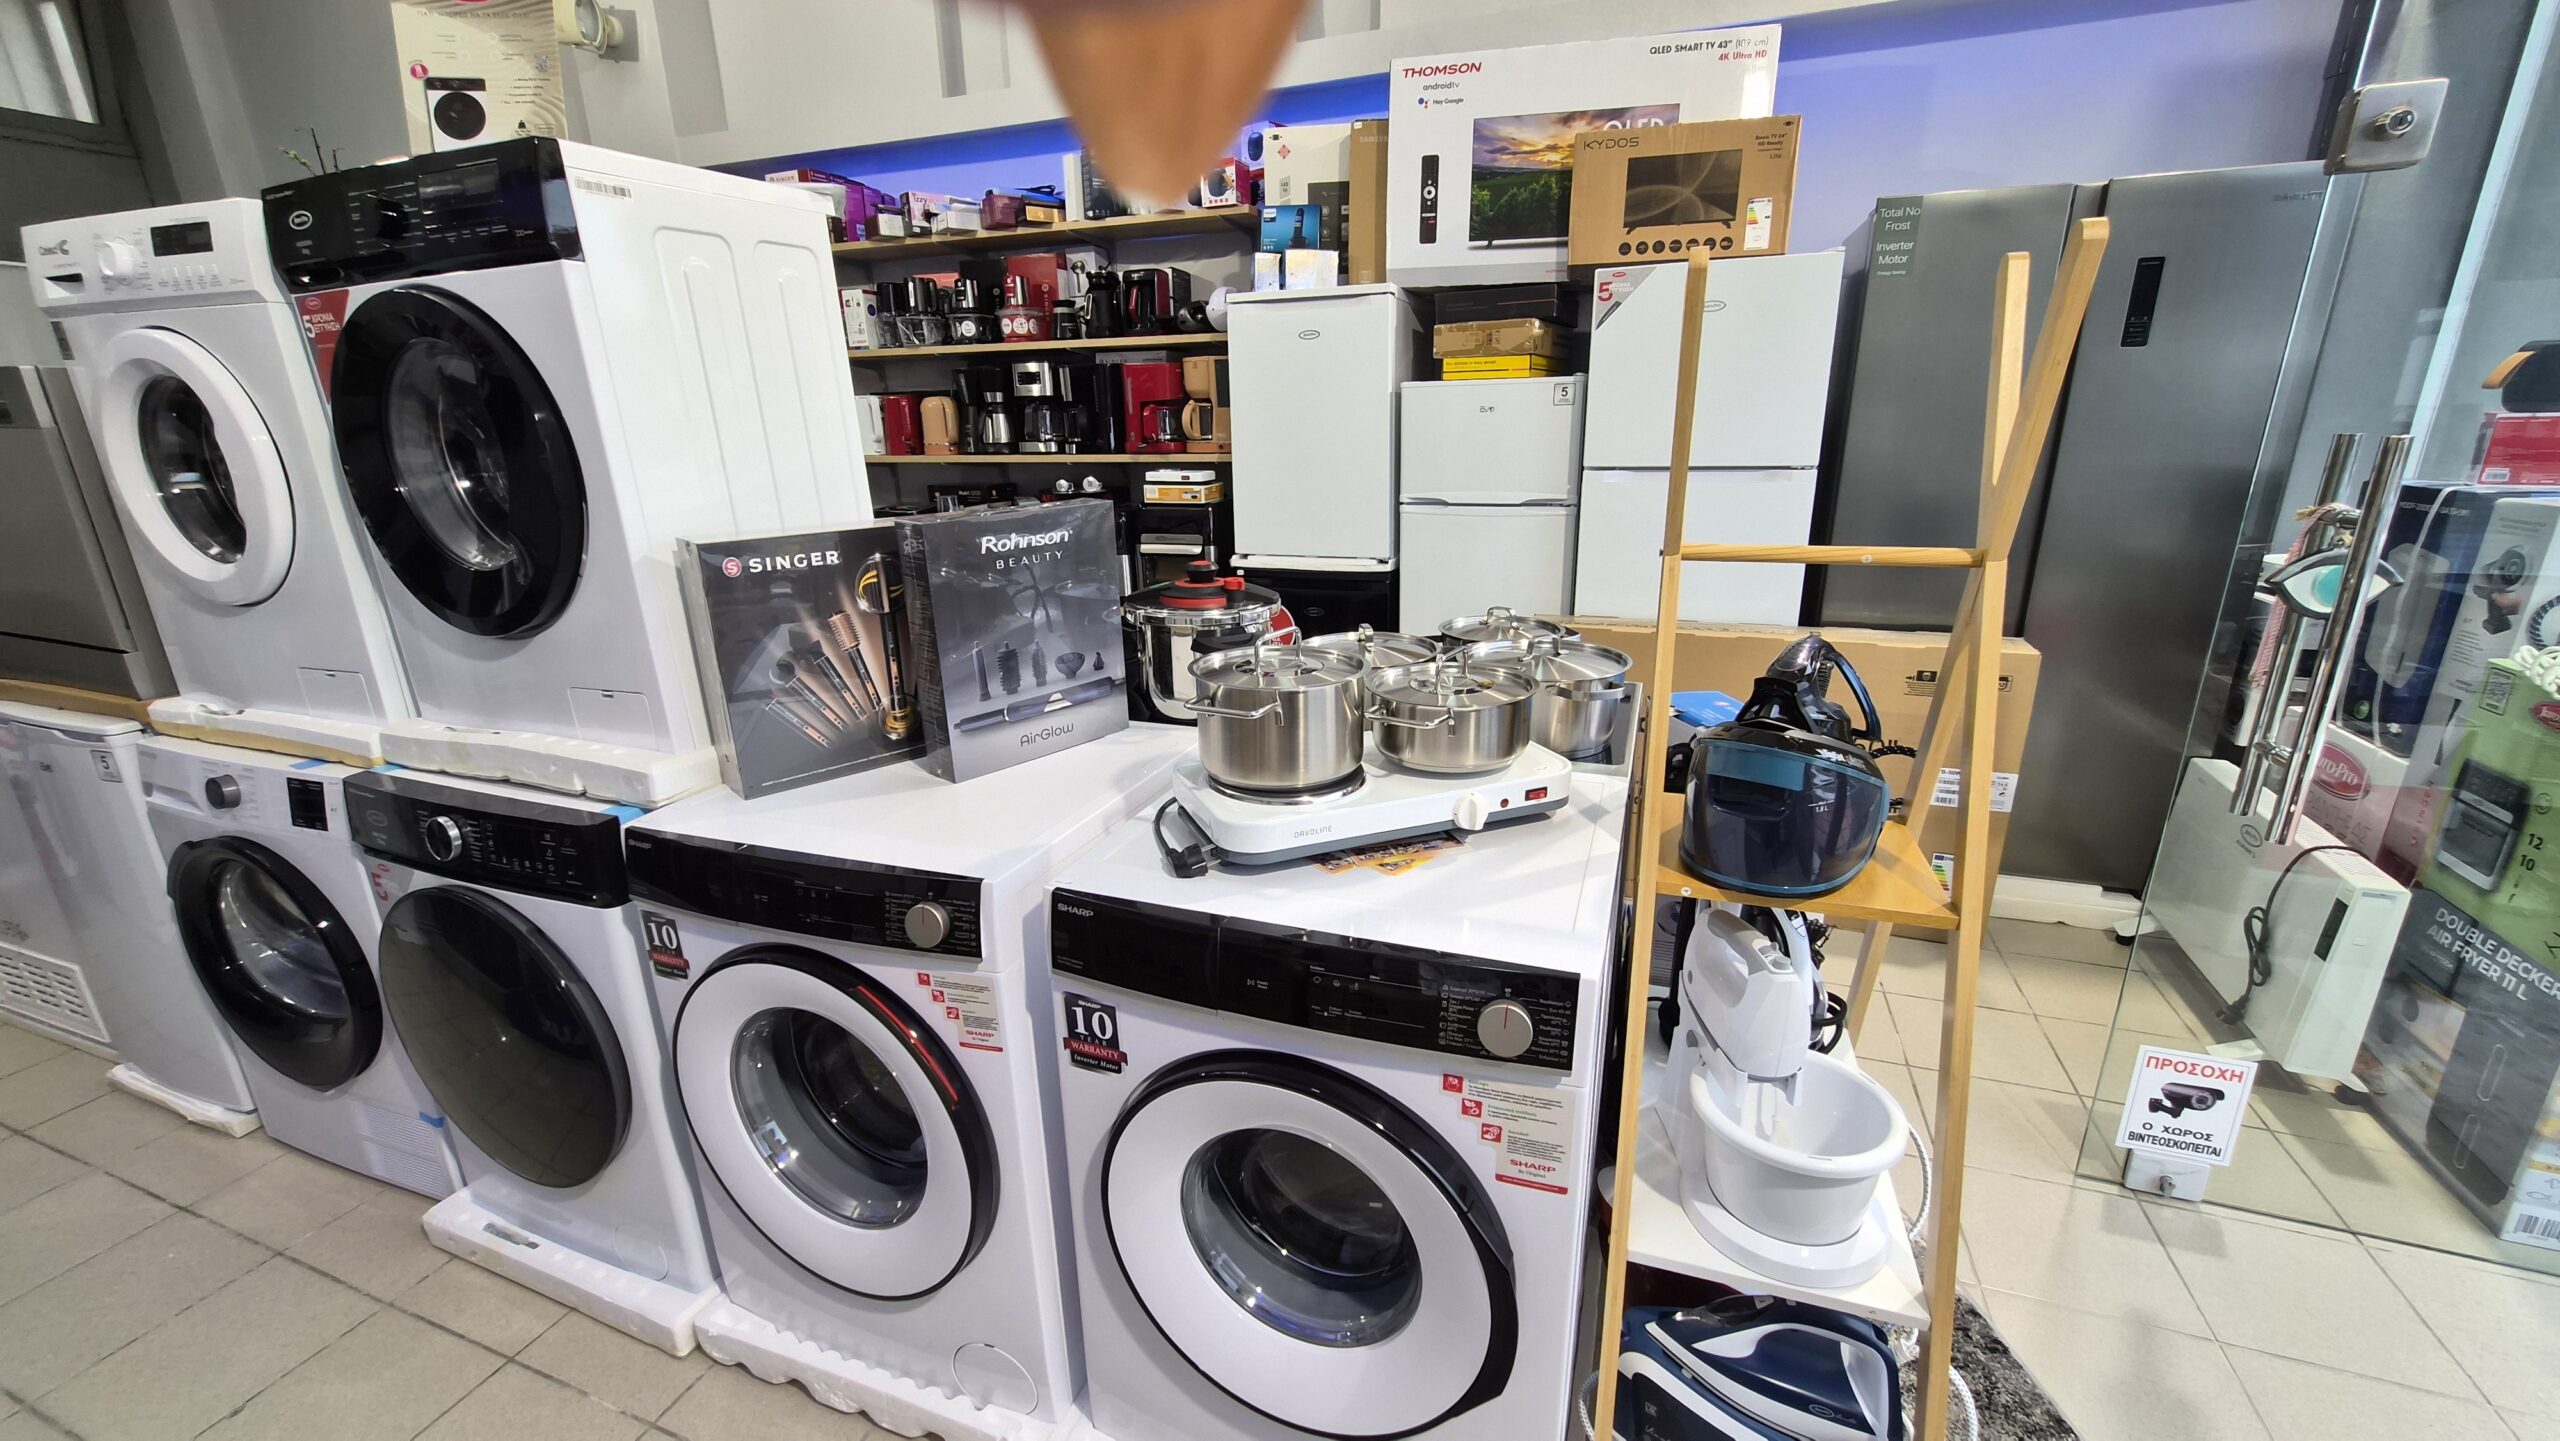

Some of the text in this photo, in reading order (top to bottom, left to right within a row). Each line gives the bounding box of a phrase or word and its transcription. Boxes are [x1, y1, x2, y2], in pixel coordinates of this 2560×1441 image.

[1650, 45, 1672, 55] QLED
[1674, 42, 1703, 53] SMART
[1706, 41, 1716, 50] TV
[1718, 49, 1767, 61] 4K Ultra HD
[1402, 62, 1482, 78] THOMSON
[1433, 96, 1464, 106] Hey Google
[1583, 136, 1640, 150] KYDOS
[1880, 206, 1920, 218] Total No
[1885, 221, 1911, 231] Frost
[1876, 241, 1915, 252] Inverter
[1878, 255, 1909, 265] Motor
[1597, 281, 1613, 302] 5
[302, 315, 316, 338] 5
[1561, 386, 1569, 397] 5
[981, 531, 1069, 554] Rohnson
[748, 550, 841, 573] SINGER
[996, 550, 1062, 569] BEAUTY
[1020, 723, 1074, 748] AirGlow
[101, 756, 110, 770] 5
[1294, 825, 1332, 838] DAVOLINE
[2528, 833, 2544, 850] 12
[2520, 854, 2535, 872] 10
[1057, 902, 1094, 917] SHARP
[648, 922, 677, 950] 10
[2426, 924, 2453, 948] AIR
[2452, 938, 2501, 982] FRYER
[2516, 983, 2528, 1001] L
[2435, 907, 2498, 955] DOUBLE
[2495, 946, 2560, 1001] DECKER
[1071, 1006, 1113, 1040] 10
[1079, 1034, 1107, 1046] YEAR
[1071, 1040, 1119, 1059] WARRANTY
[1074, 1053, 1119, 1070] Inverter Motor
[2146, 1055, 2245, 1083] ΠΡΟΣΟΧΗ
[2161, 1124, 2214, 1142] ΧΩΡΟΣ
[2127, 1130, 2222, 1157] ΒΙΝΤΕΟΣΚΟΠΕΙΤΑΙ
[1509, 1159, 1557, 1173] SHARP
